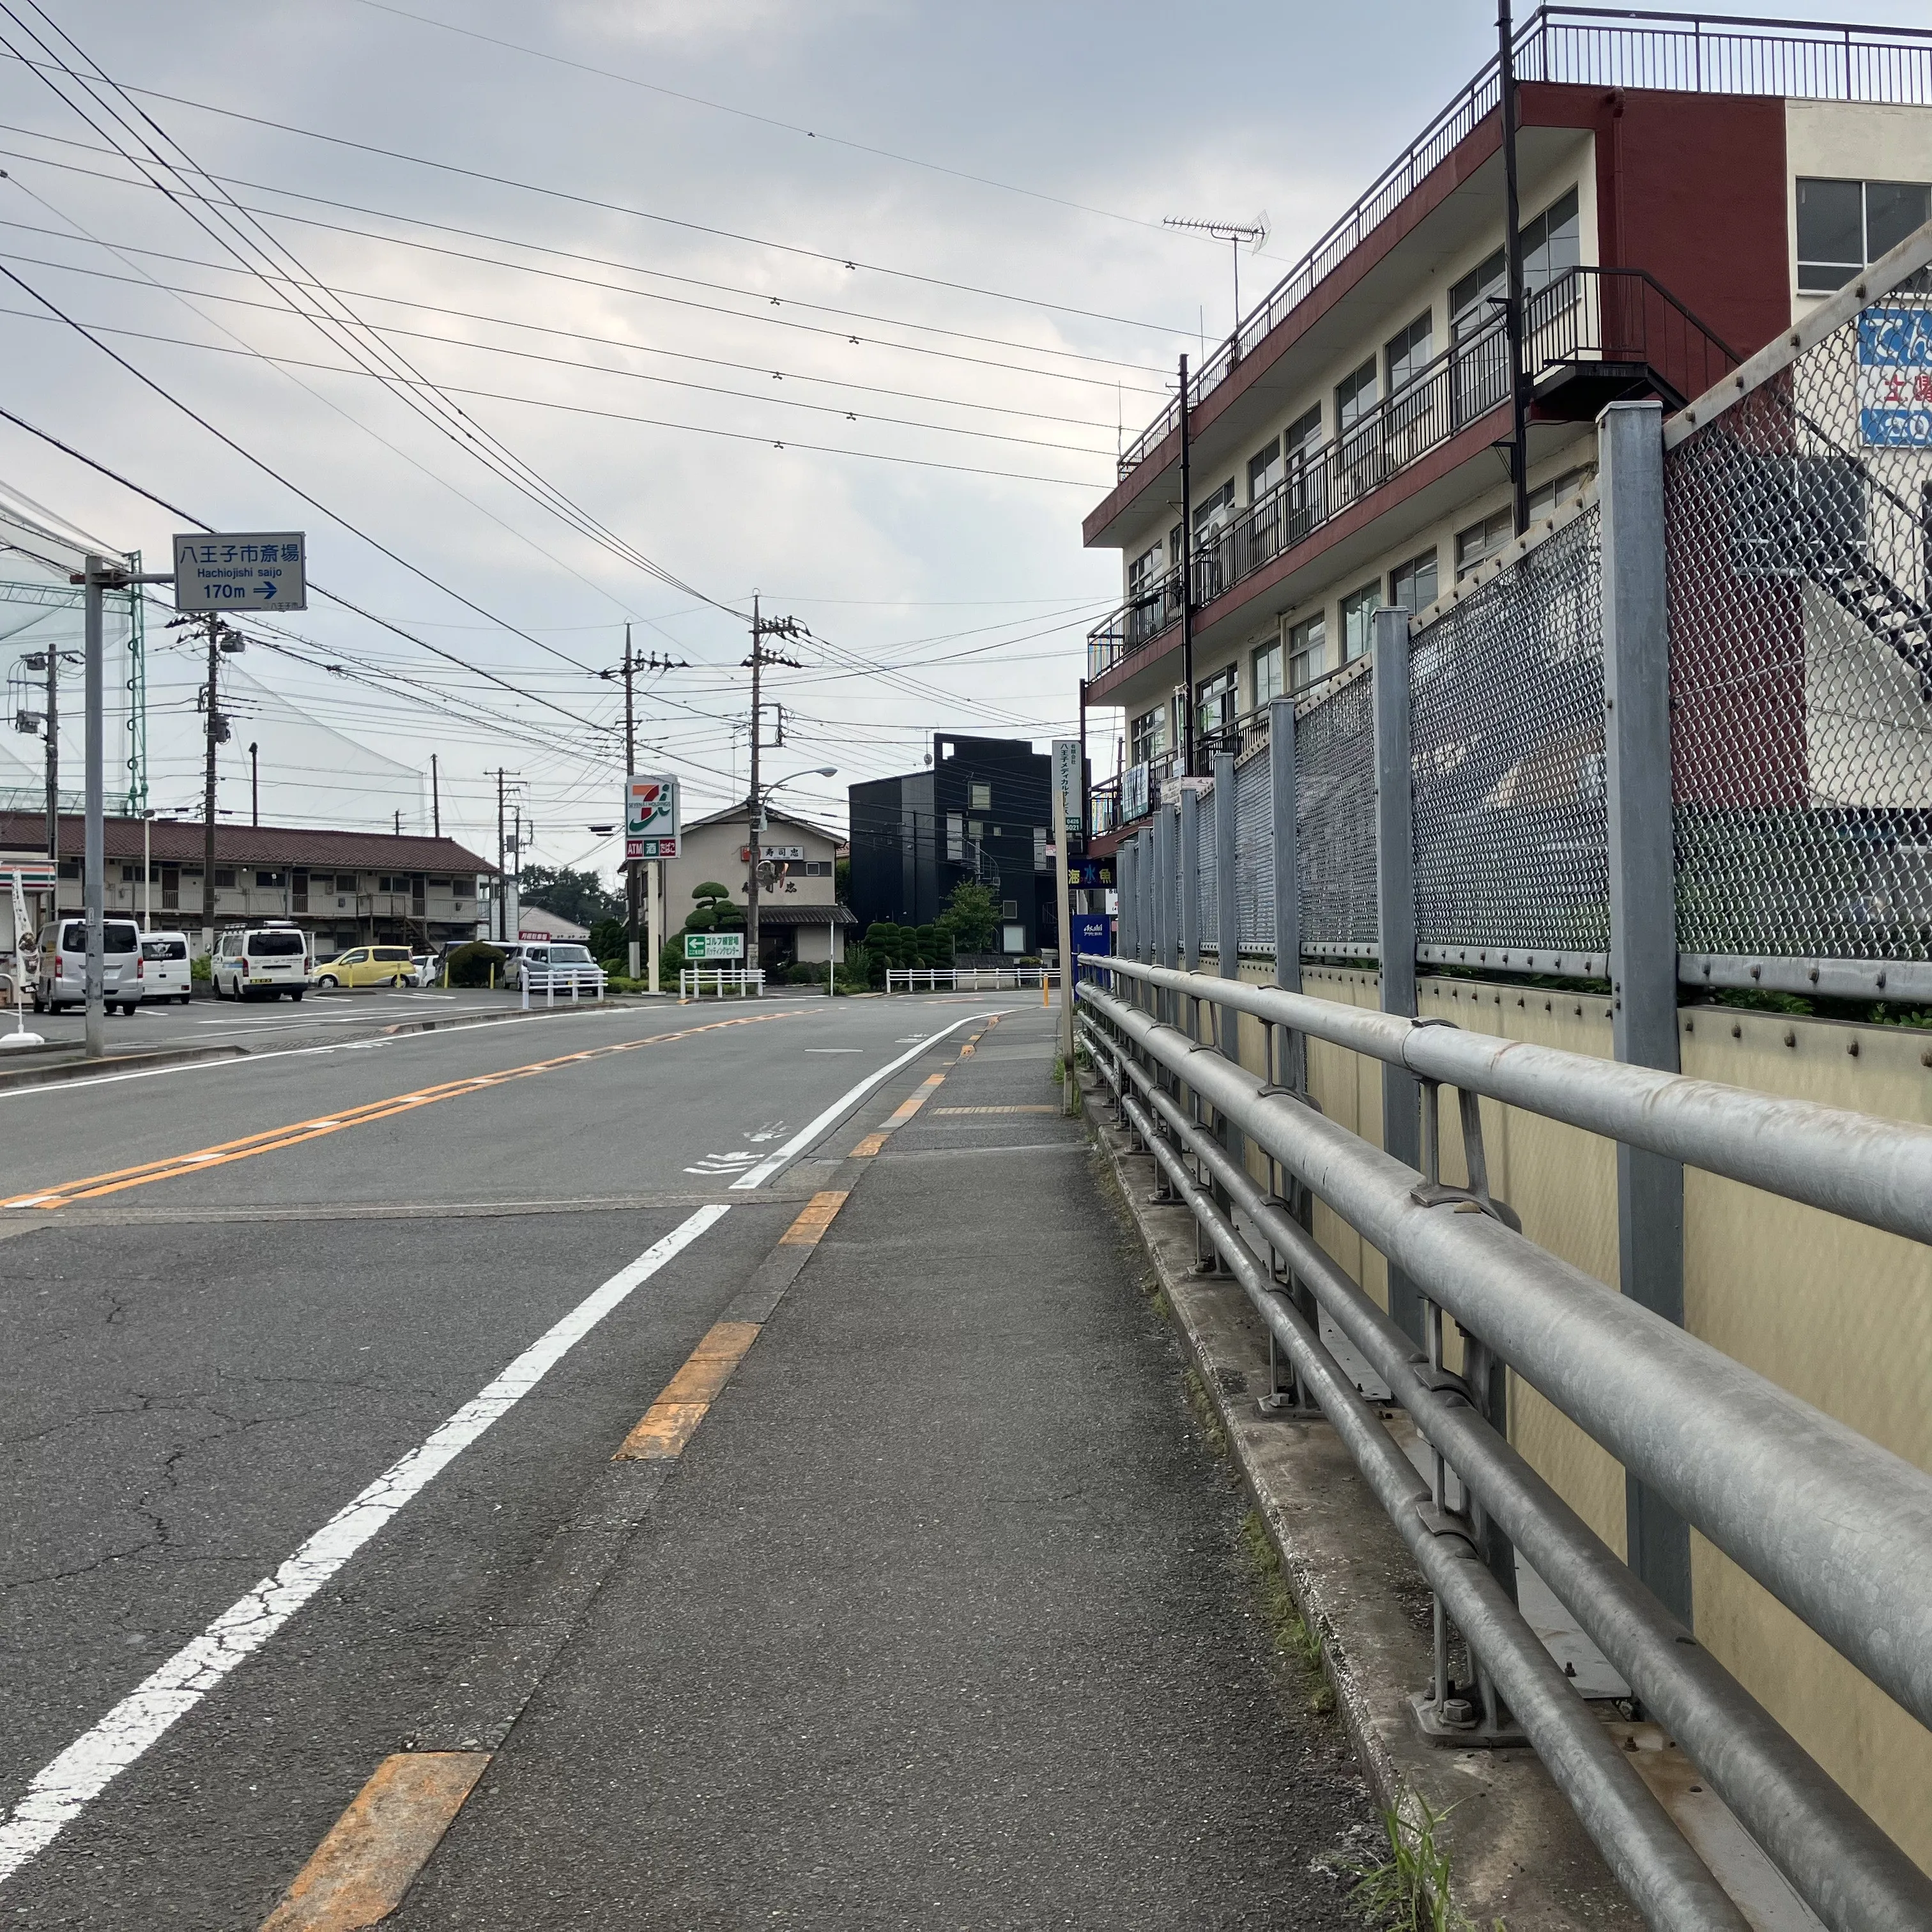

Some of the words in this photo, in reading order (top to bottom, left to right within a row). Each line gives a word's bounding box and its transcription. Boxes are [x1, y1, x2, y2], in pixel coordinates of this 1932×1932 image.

[180, 544, 300, 564] 八王子市斎場
[197, 567, 253, 579] Hachiojishi
[257, 567, 282, 579] saijo
[204, 584, 245, 599] 170m
[627, 843, 643, 855] ATM
[646, 843, 657, 854] 酒
[660, 842, 676, 854] たばこ
[765, 847, 799, 857] 寿司忠
[1068, 864, 1112, 884] 海水魚
[1084, 923, 1103, 931] Asahi
